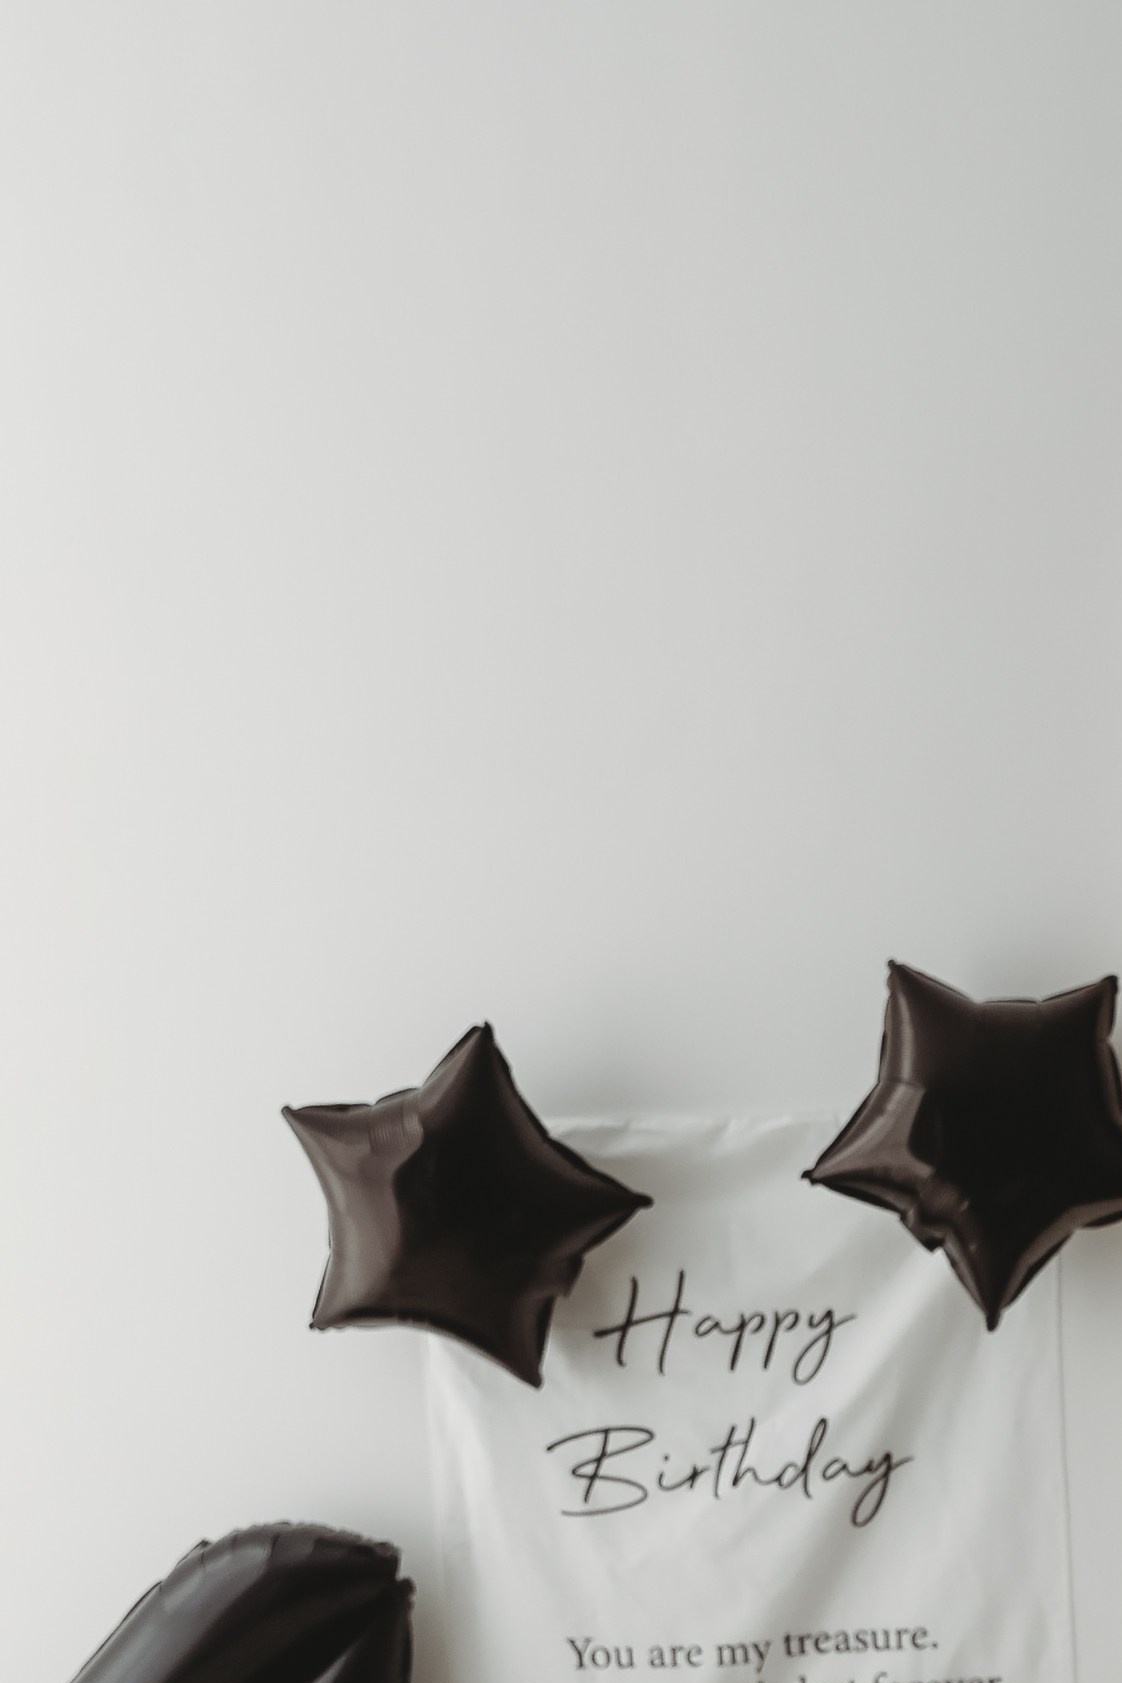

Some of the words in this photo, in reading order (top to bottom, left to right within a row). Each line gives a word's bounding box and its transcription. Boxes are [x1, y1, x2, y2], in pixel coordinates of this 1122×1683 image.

[592, 1269, 857, 1386] Happy
[545, 1416, 914, 1528] Birthday
[566, 1636, 635, 1670] You
[647, 1645, 703, 1669] are
[716, 1640, 772, 1675] my
[783, 1624, 939, 1660] treasure.
